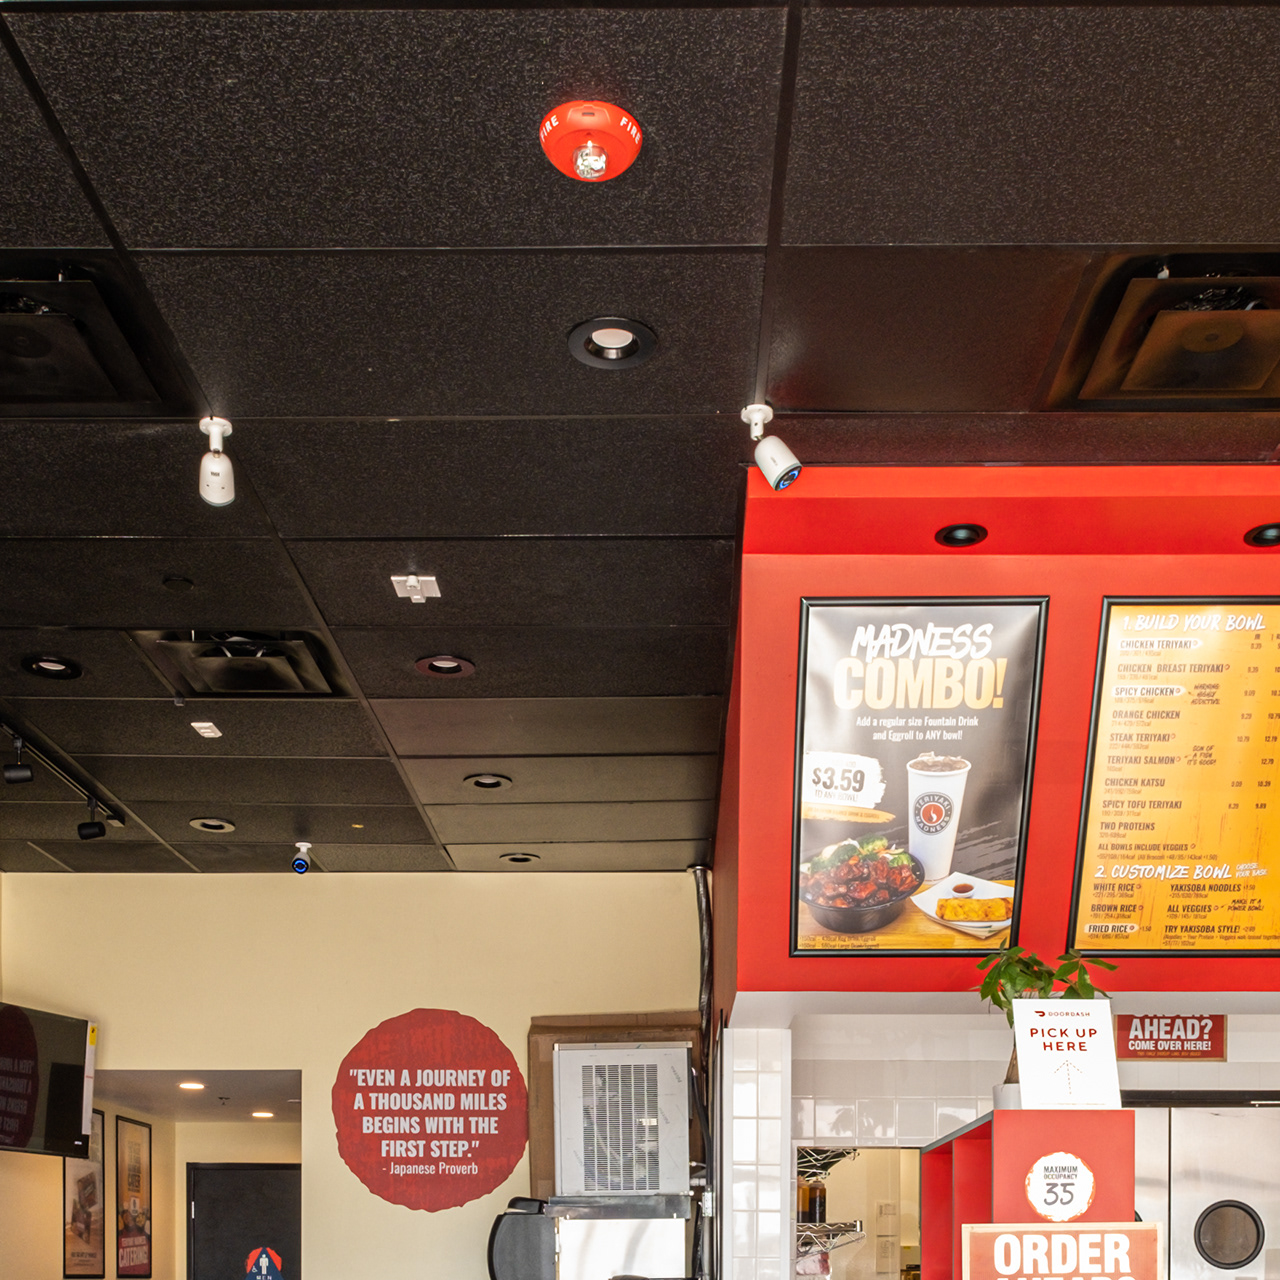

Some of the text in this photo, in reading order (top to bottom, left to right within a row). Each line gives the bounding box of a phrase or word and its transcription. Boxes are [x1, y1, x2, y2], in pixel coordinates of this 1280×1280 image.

[540, 115, 559, 142] FIRE
[620, 116, 641, 144] FIRE
[1123, 615, 1132, 630] 1.
[1135, 614, 1179, 631] BUILD
[1183, 614, 1221, 631] YOUR
[1225, 613, 1266, 631] BOWL
[850, 621, 994, 663] MADNESS
[833, 657, 1008, 712] COMBO!
[1115, 687, 1174, 696] SPICY CHICKEN
[856, 716, 979, 729] Add a regular size Fountain Drink
[1112, 710, 1181, 719] ORANGE CHICKEN
[872, 730, 963, 742] and Eggroll to ANY bowl!
[1107, 756, 1175, 765] TERIYAKI SALMON
[812, 767, 866, 793] $3.59
[916, 794, 950, 811] TERIYAKI
[916, 815, 950, 834] MADNESS
[1094, 864, 1232, 880] 2. CUSTOMIZE BOWL
[1170, 884, 1242, 892] YAKISOBA NOODLES
[1088, 925, 1128, 933] FRIED RICE
[1030, 1028, 1097, 1038] PICK UP
[1128, 1019, 1213, 1040] AHEAD?
[1043, 1042, 1088, 1051] HERE
[1128, 1040, 1211, 1050] COME OVER HERE!
[349, 1069, 511, 1087] "EVEN A JOURNEY OF
[354, 1093, 507, 1110] A THOUSAND MILES
[362, 1117, 499, 1134] BEGINS WITH THE
[381, 1140, 480, 1157] FIRST STEP."
[390, 1162, 479, 1177] Japanese Proverb
[1043, 1183, 1075, 1206] 35
[993, 1233, 1132, 1275] ORDER
